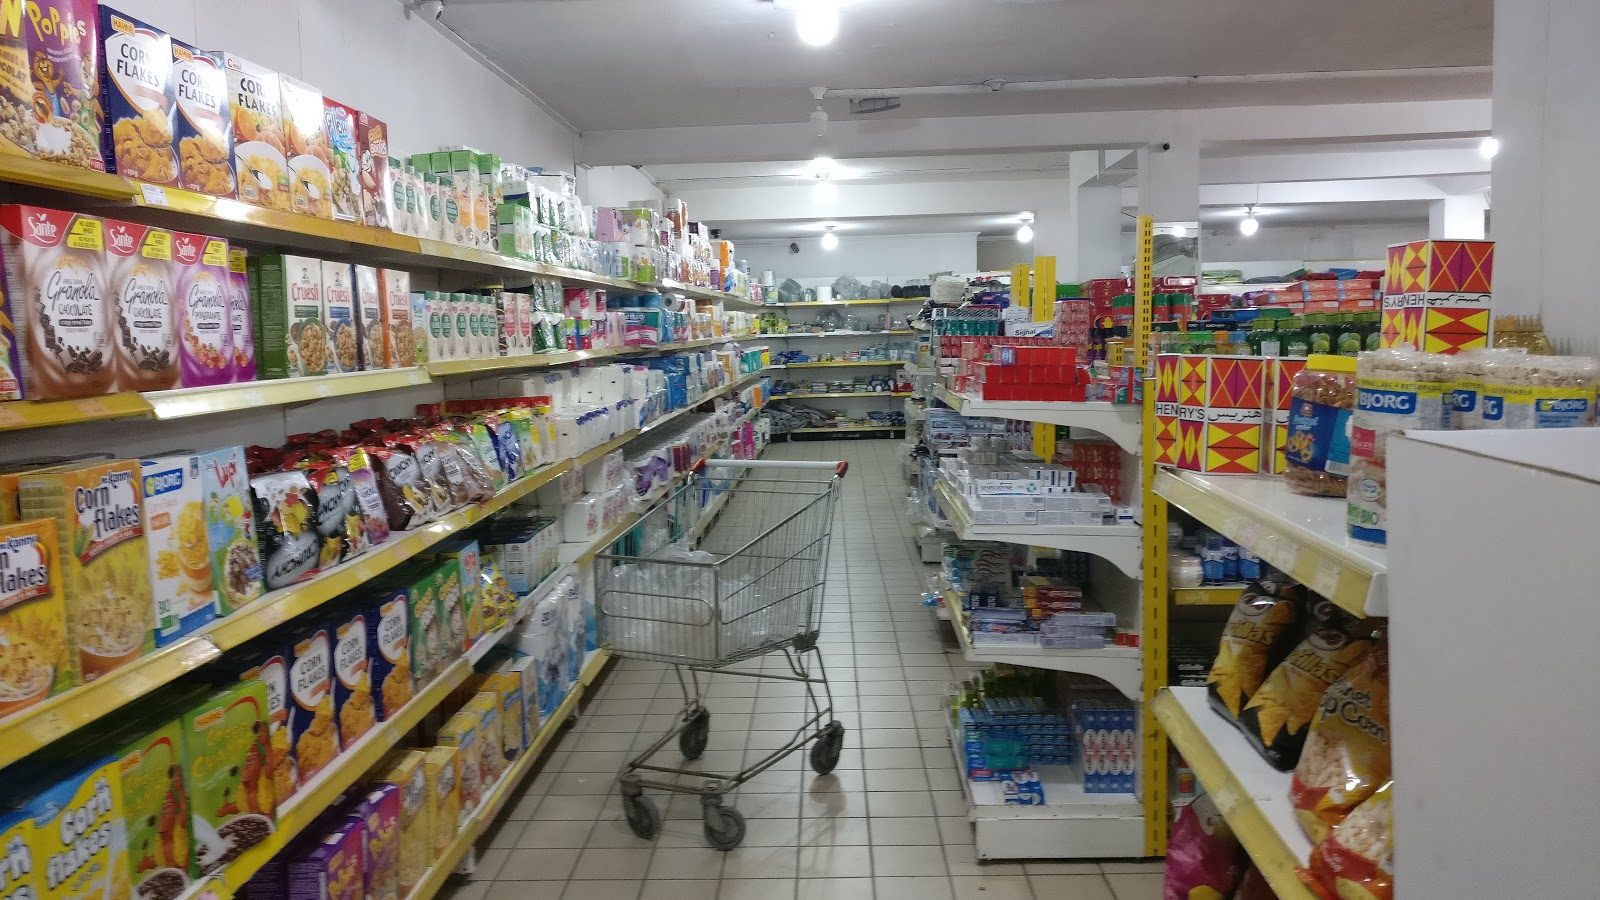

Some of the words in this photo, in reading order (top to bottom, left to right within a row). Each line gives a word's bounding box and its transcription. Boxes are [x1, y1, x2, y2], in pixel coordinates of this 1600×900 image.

[116, 59, 160, 87] FLAKES
[178, 83, 216, 108] FLAKES
[238, 92, 277, 117] FLAKES
[28, 216, 57, 244] Sante
[110, 228, 134, 253] Sante
[176, 240, 196, 262] Sante
[46, 270, 99, 312] Granola
[124, 277, 168, 314] Granola
[1156, 403, 1205, 420] HENRY'S
[1360, 391, 1410, 410] BJORG
[1207, 410, 1262, 422] هنريس
[75, 487, 109, 513] Corn
[94, 504, 140, 538] flakes
